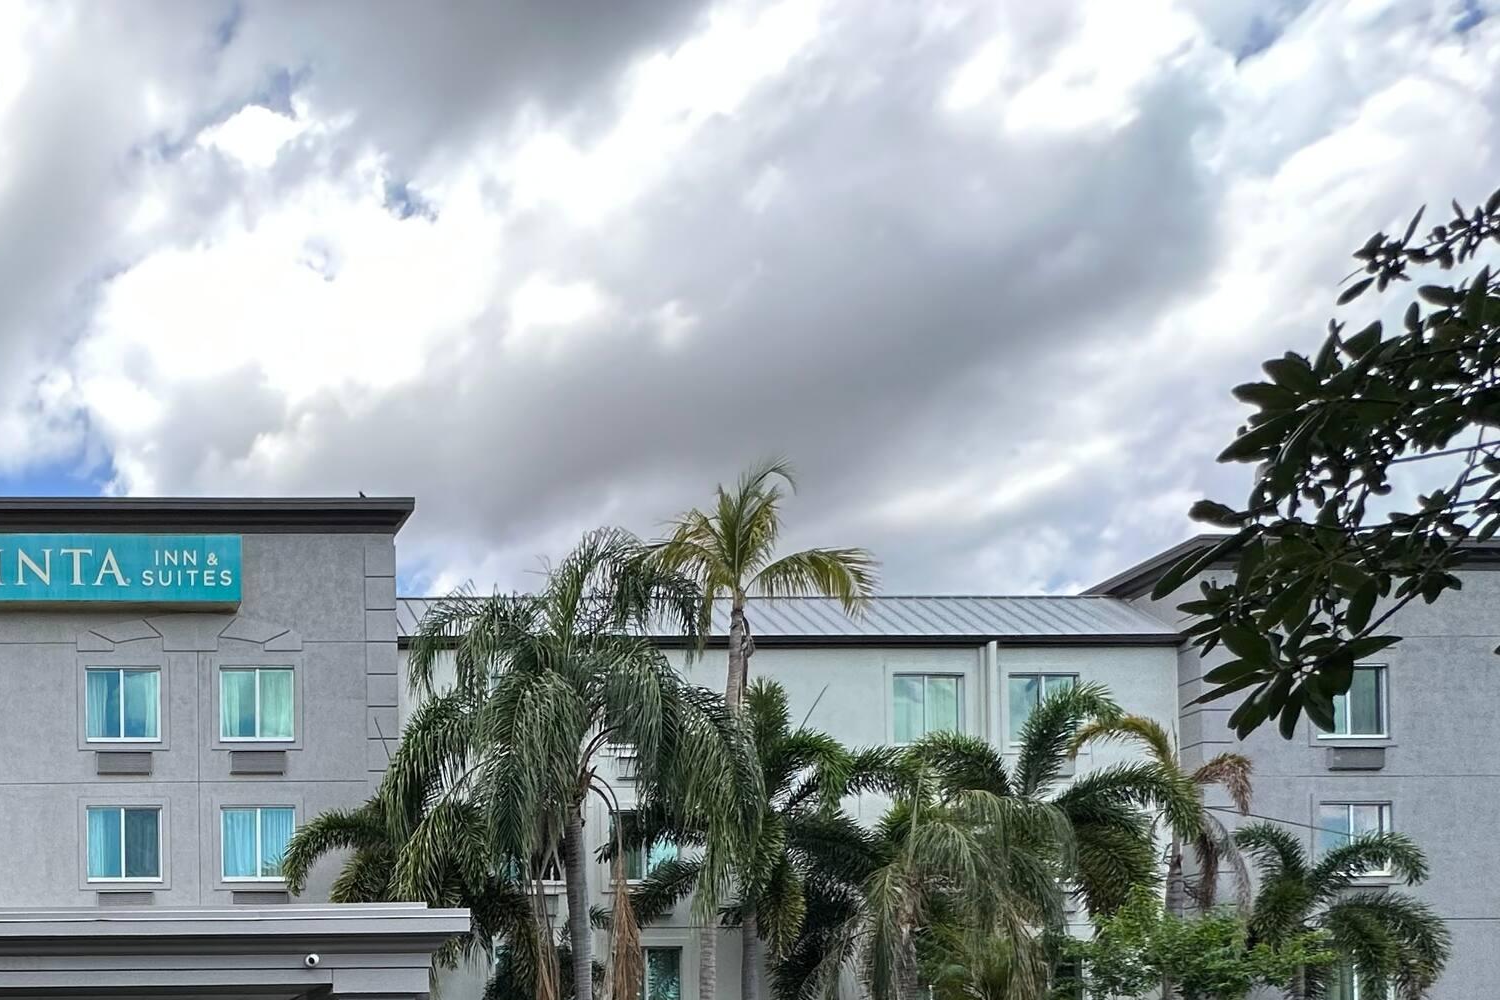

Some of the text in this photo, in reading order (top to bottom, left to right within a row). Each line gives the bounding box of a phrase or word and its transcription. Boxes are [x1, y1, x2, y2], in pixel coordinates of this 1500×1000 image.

[154, 549, 219, 566] INN &
[140, 569, 233, 588] SUITES
